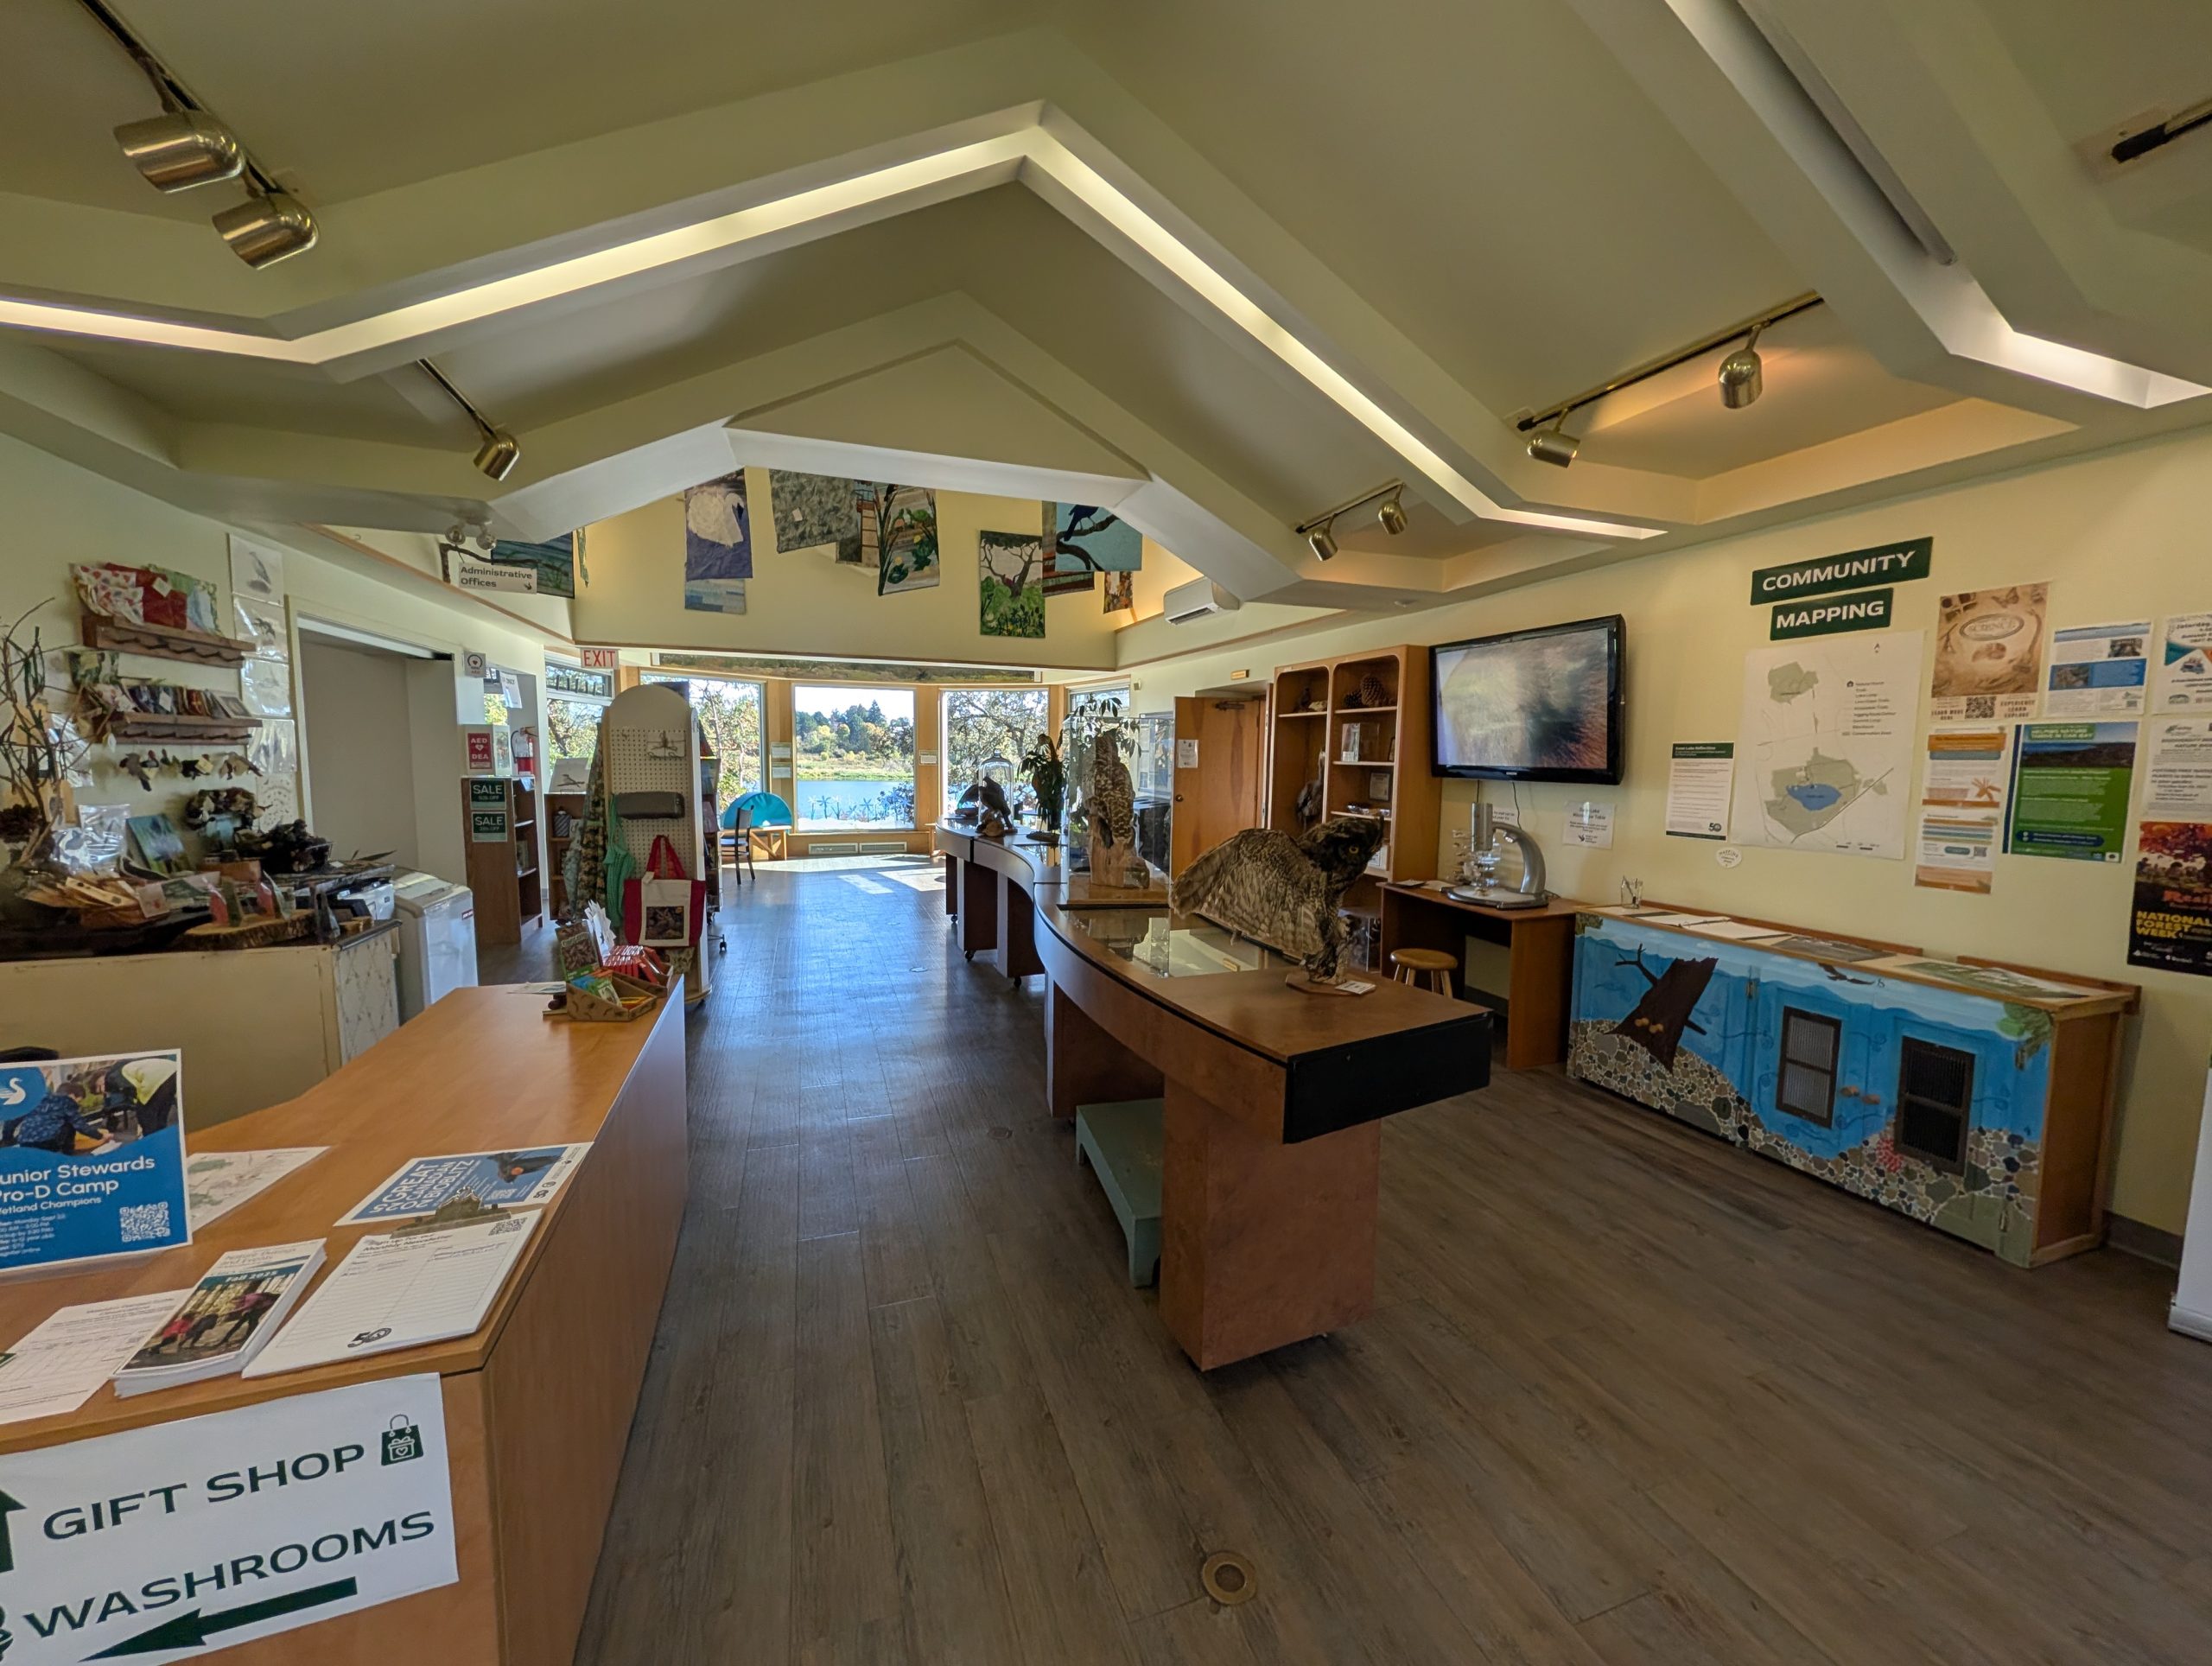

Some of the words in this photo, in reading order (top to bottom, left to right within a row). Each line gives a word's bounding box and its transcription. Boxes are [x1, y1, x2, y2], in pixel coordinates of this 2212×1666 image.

[461, 567, 532, 579] Administrative
[1762, 550, 1916, 591] COMMUNITY
[461, 577, 497, 588] Offices
[1777, 601, 1885, 628] MAPPING
[583, 649, 616, 666] EXIT
[473, 784, 503, 795] SALE
[475, 816, 504, 826] SALE
[2136, 911, 2212, 926] NATIONAL
[2136, 919, 2191, 932] FOREST
[2136, 926, 2177, 938] WEEK
[0, 1168, 52, 1185] unior
[57, 1155, 156, 1179] Stewards
[56, 1180, 119, 1195] Camp
[383, 1163, 429, 1202] GREAT
[405, 1160, 457, 1202] CANADIAN
[423, 1159, 475, 1202] BIOBLITZ
[41, 1197, 102, 1209] Champions
[225, 1274, 248, 1283] Fall
[248, 1270, 278, 1280] 2025
[42, 1483, 188, 1541] GIFT
[206, 1443, 365, 1504] SHOP
[22, 1510, 435, 1638] WASHROOMS
